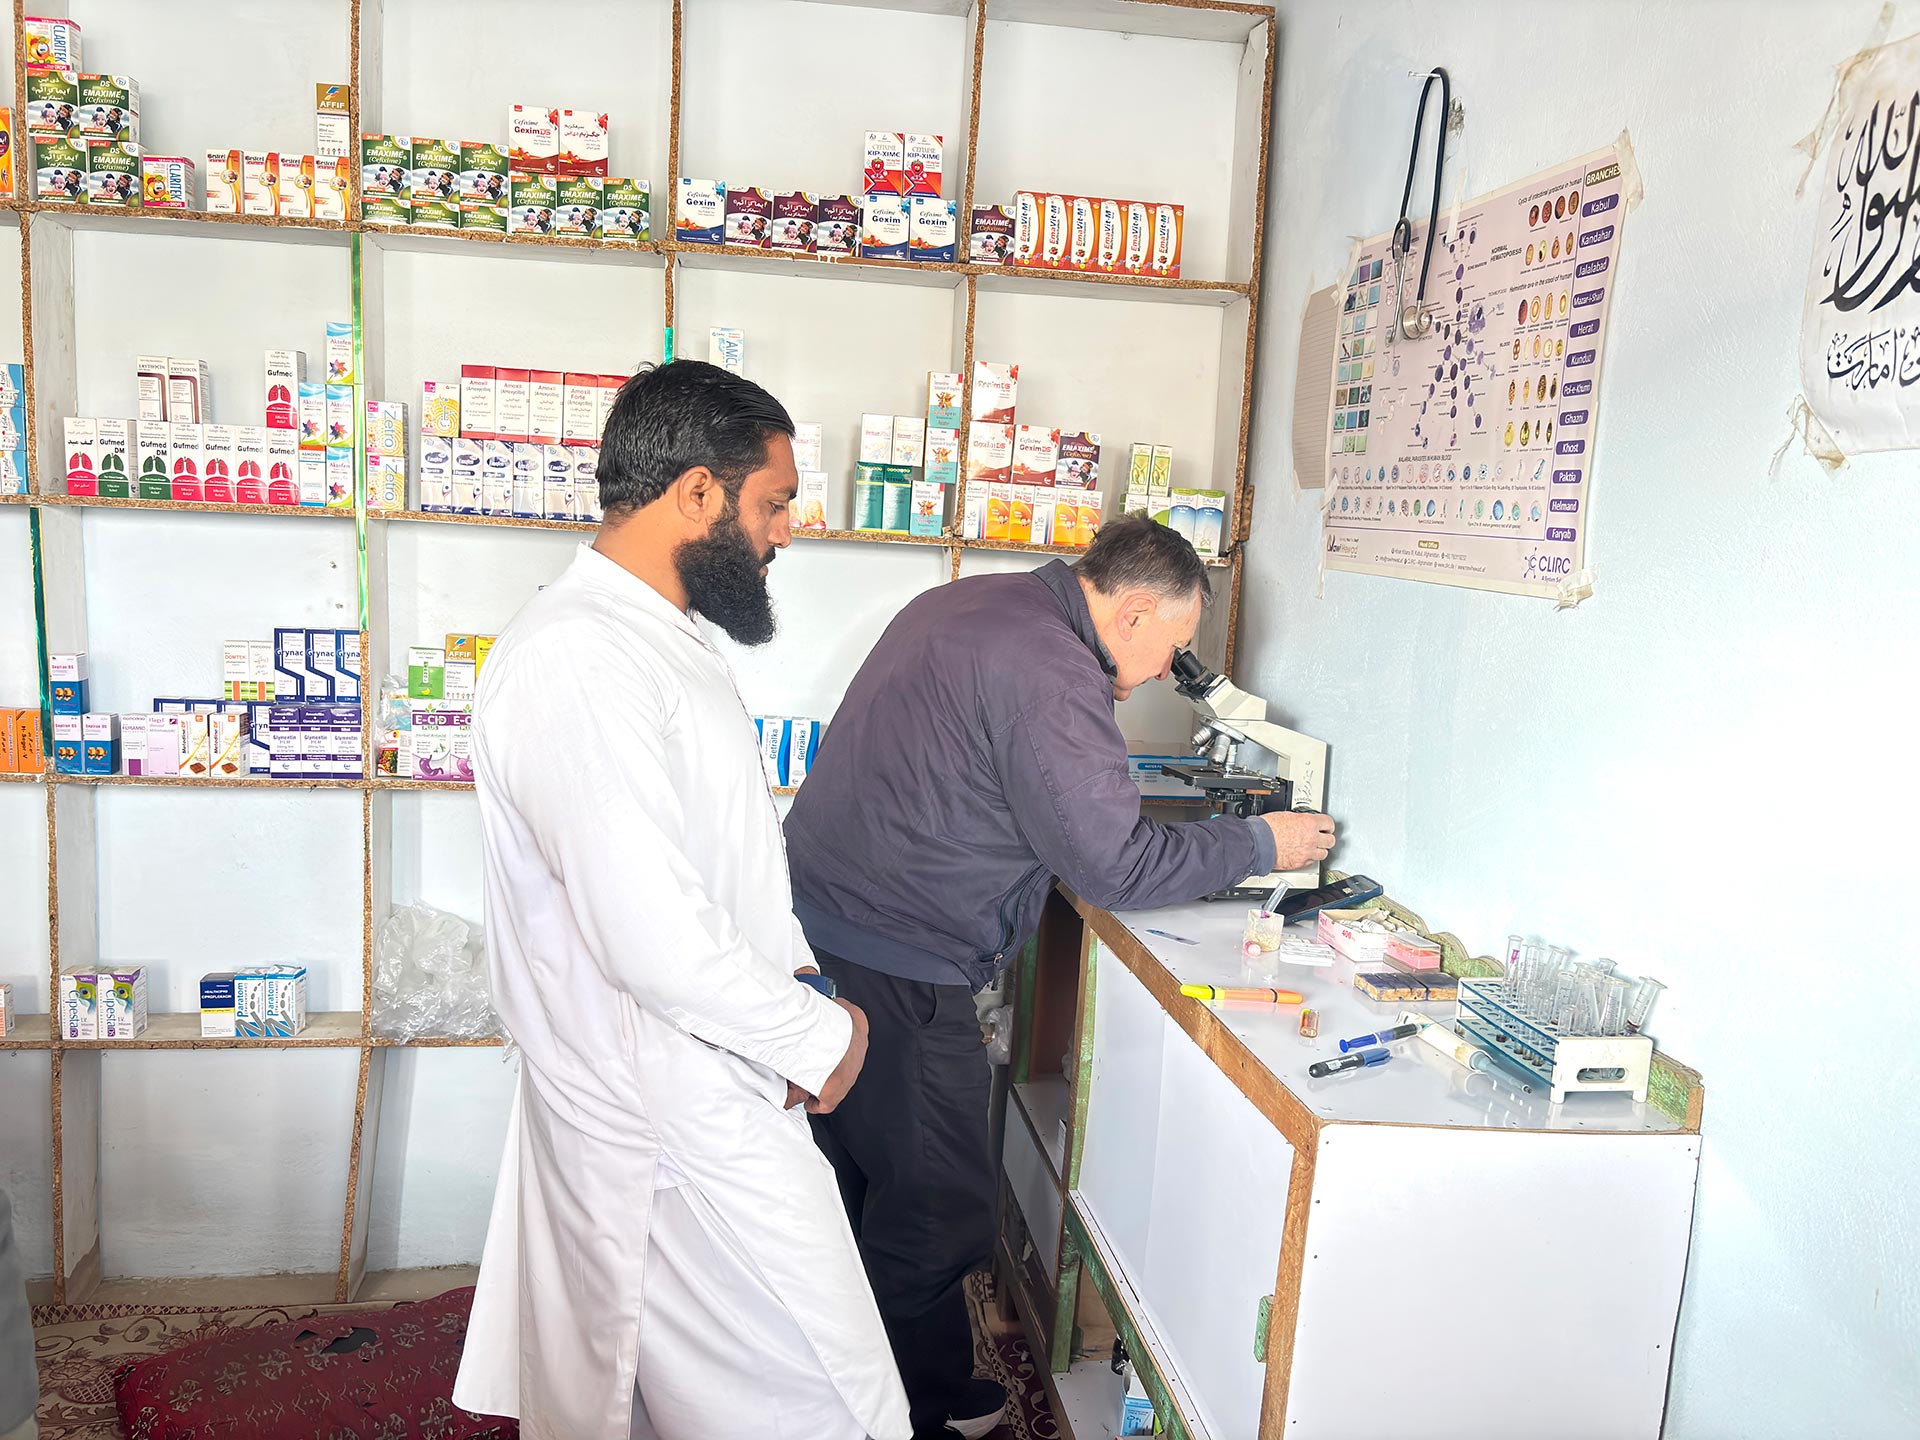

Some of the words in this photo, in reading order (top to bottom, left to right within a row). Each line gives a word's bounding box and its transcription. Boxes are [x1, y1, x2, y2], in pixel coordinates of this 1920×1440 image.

[53, 25, 66, 63] CLARITEK
[83, 89, 121, 97] EMAXIME
[366, 149, 404, 158] EMAXIME
[415, 153, 453, 162] EMAXIME
[93, 156, 131, 164] EMAXIME
[169, 163, 182, 200] CLARITEK
[1586, 166, 1622, 187] BRANCHES
[514, 192, 551, 200] EMAXIME
[560, 191, 597, 199] EMAXIME
[607, 192, 643, 201] EMAXIME
[687, 190, 711, 199] Cefixime
[366, 203, 397, 211] EMAXIME
[686, 198, 716, 207] Gexim
[1590, 198, 1611, 214] Kabul
[415, 207, 446, 216] EMAXIME
[463, 211, 492, 221] EMAXIME
[872, 207, 897, 216] Cefixime
[919, 209, 943, 218] Cefixime
[872, 215, 901, 224] Gexim
[919, 217, 948, 226] Gexim
[975, 218, 1010, 227] EMAXIME
[1580, 229, 1613, 247] Kandahar
[1577, 259, 1608, 278] Jalalabad
[1577, 323, 1595, 336] Herat
[267, 369, 293, 377] Gufmed
[1564, 411, 1586, 425] Ghazni
[384, 410, 397, 448] Zetro
[100, 438, 126, 446] Gufmed
[140, 440, 168, 448] Gufmed
[173, 442, 200, 450] Gufmed
[205, 443, 231, 451] Gufmed
[1563, 442, 1580, 452] Khost
[269, 446, 296, 454] Gufmed
[1559, 470, 1577, 482] Paktia
[384, 463, 398, 501] Zetro
[1551, 501, 1578, 511] Helmand
[1551, 528, 1571, 542] Faryab
[1538, 555, 1571, 574] CLIRC
[275, 648, 304, 659] Grynac
[306, 649, 335, 659] Grynac
[337, 648, 361, 660] Gryna
[448, 651, 473, 659] AFFIF
[415, 714, 447, 725] E-CID
[453, 714, 472, 725] E-C
[236, 982, 245, 1018] Paratom
[266, 981, 275, 1017] Paratom
[65, 989, 80, 1030] Cipesta
[102, 989, 117, 1030] Cipesta
